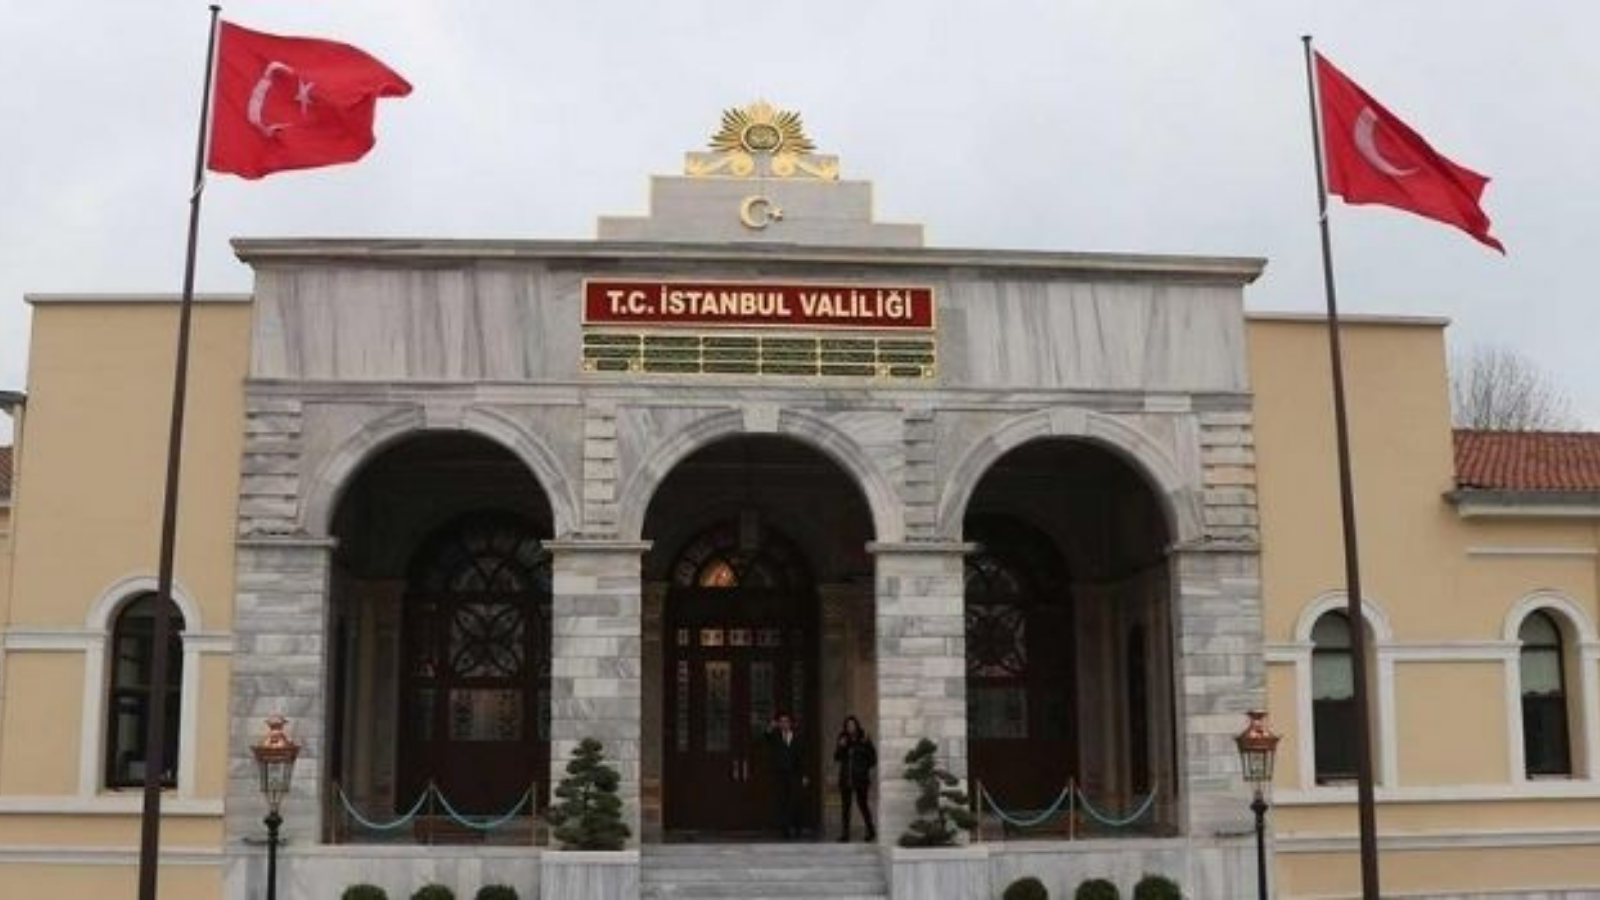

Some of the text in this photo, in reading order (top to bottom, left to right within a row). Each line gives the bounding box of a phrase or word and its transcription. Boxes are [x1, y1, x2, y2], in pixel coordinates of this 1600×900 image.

[606, 285, 913, 320] T.C. İSTANBUL VALİLİĞİ
